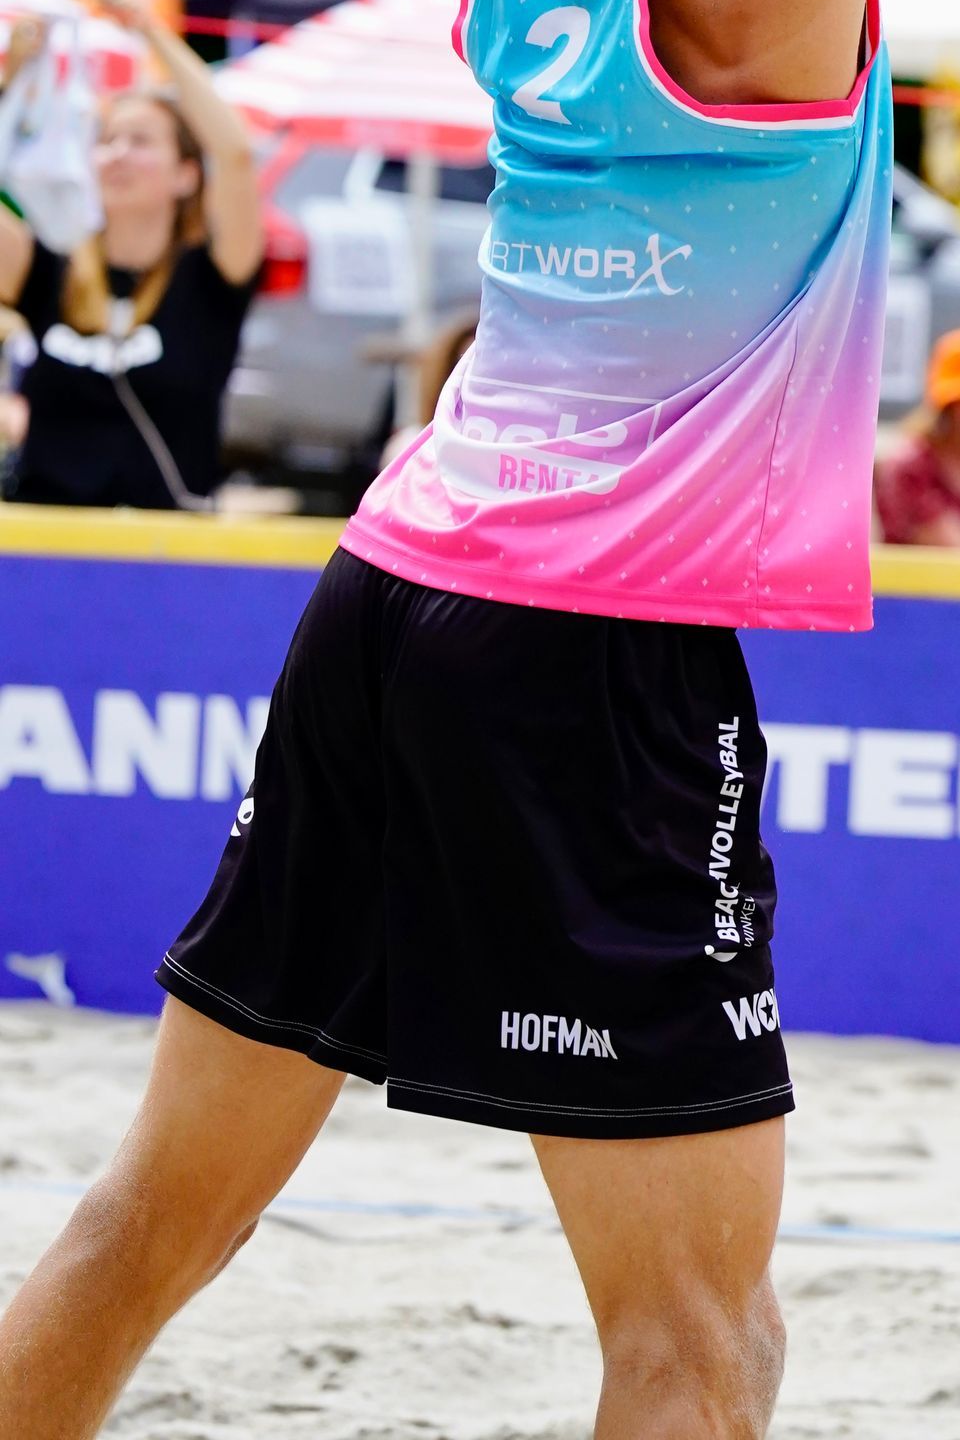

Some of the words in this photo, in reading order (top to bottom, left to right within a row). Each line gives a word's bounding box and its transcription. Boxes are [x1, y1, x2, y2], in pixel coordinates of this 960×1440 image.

[510, 5, 592, 126] 2
[489, 232, 694, 298] RTWORX
[500, 1010, 619, 1061] HOFMAN
[722, 986, 781, 1042] WO
